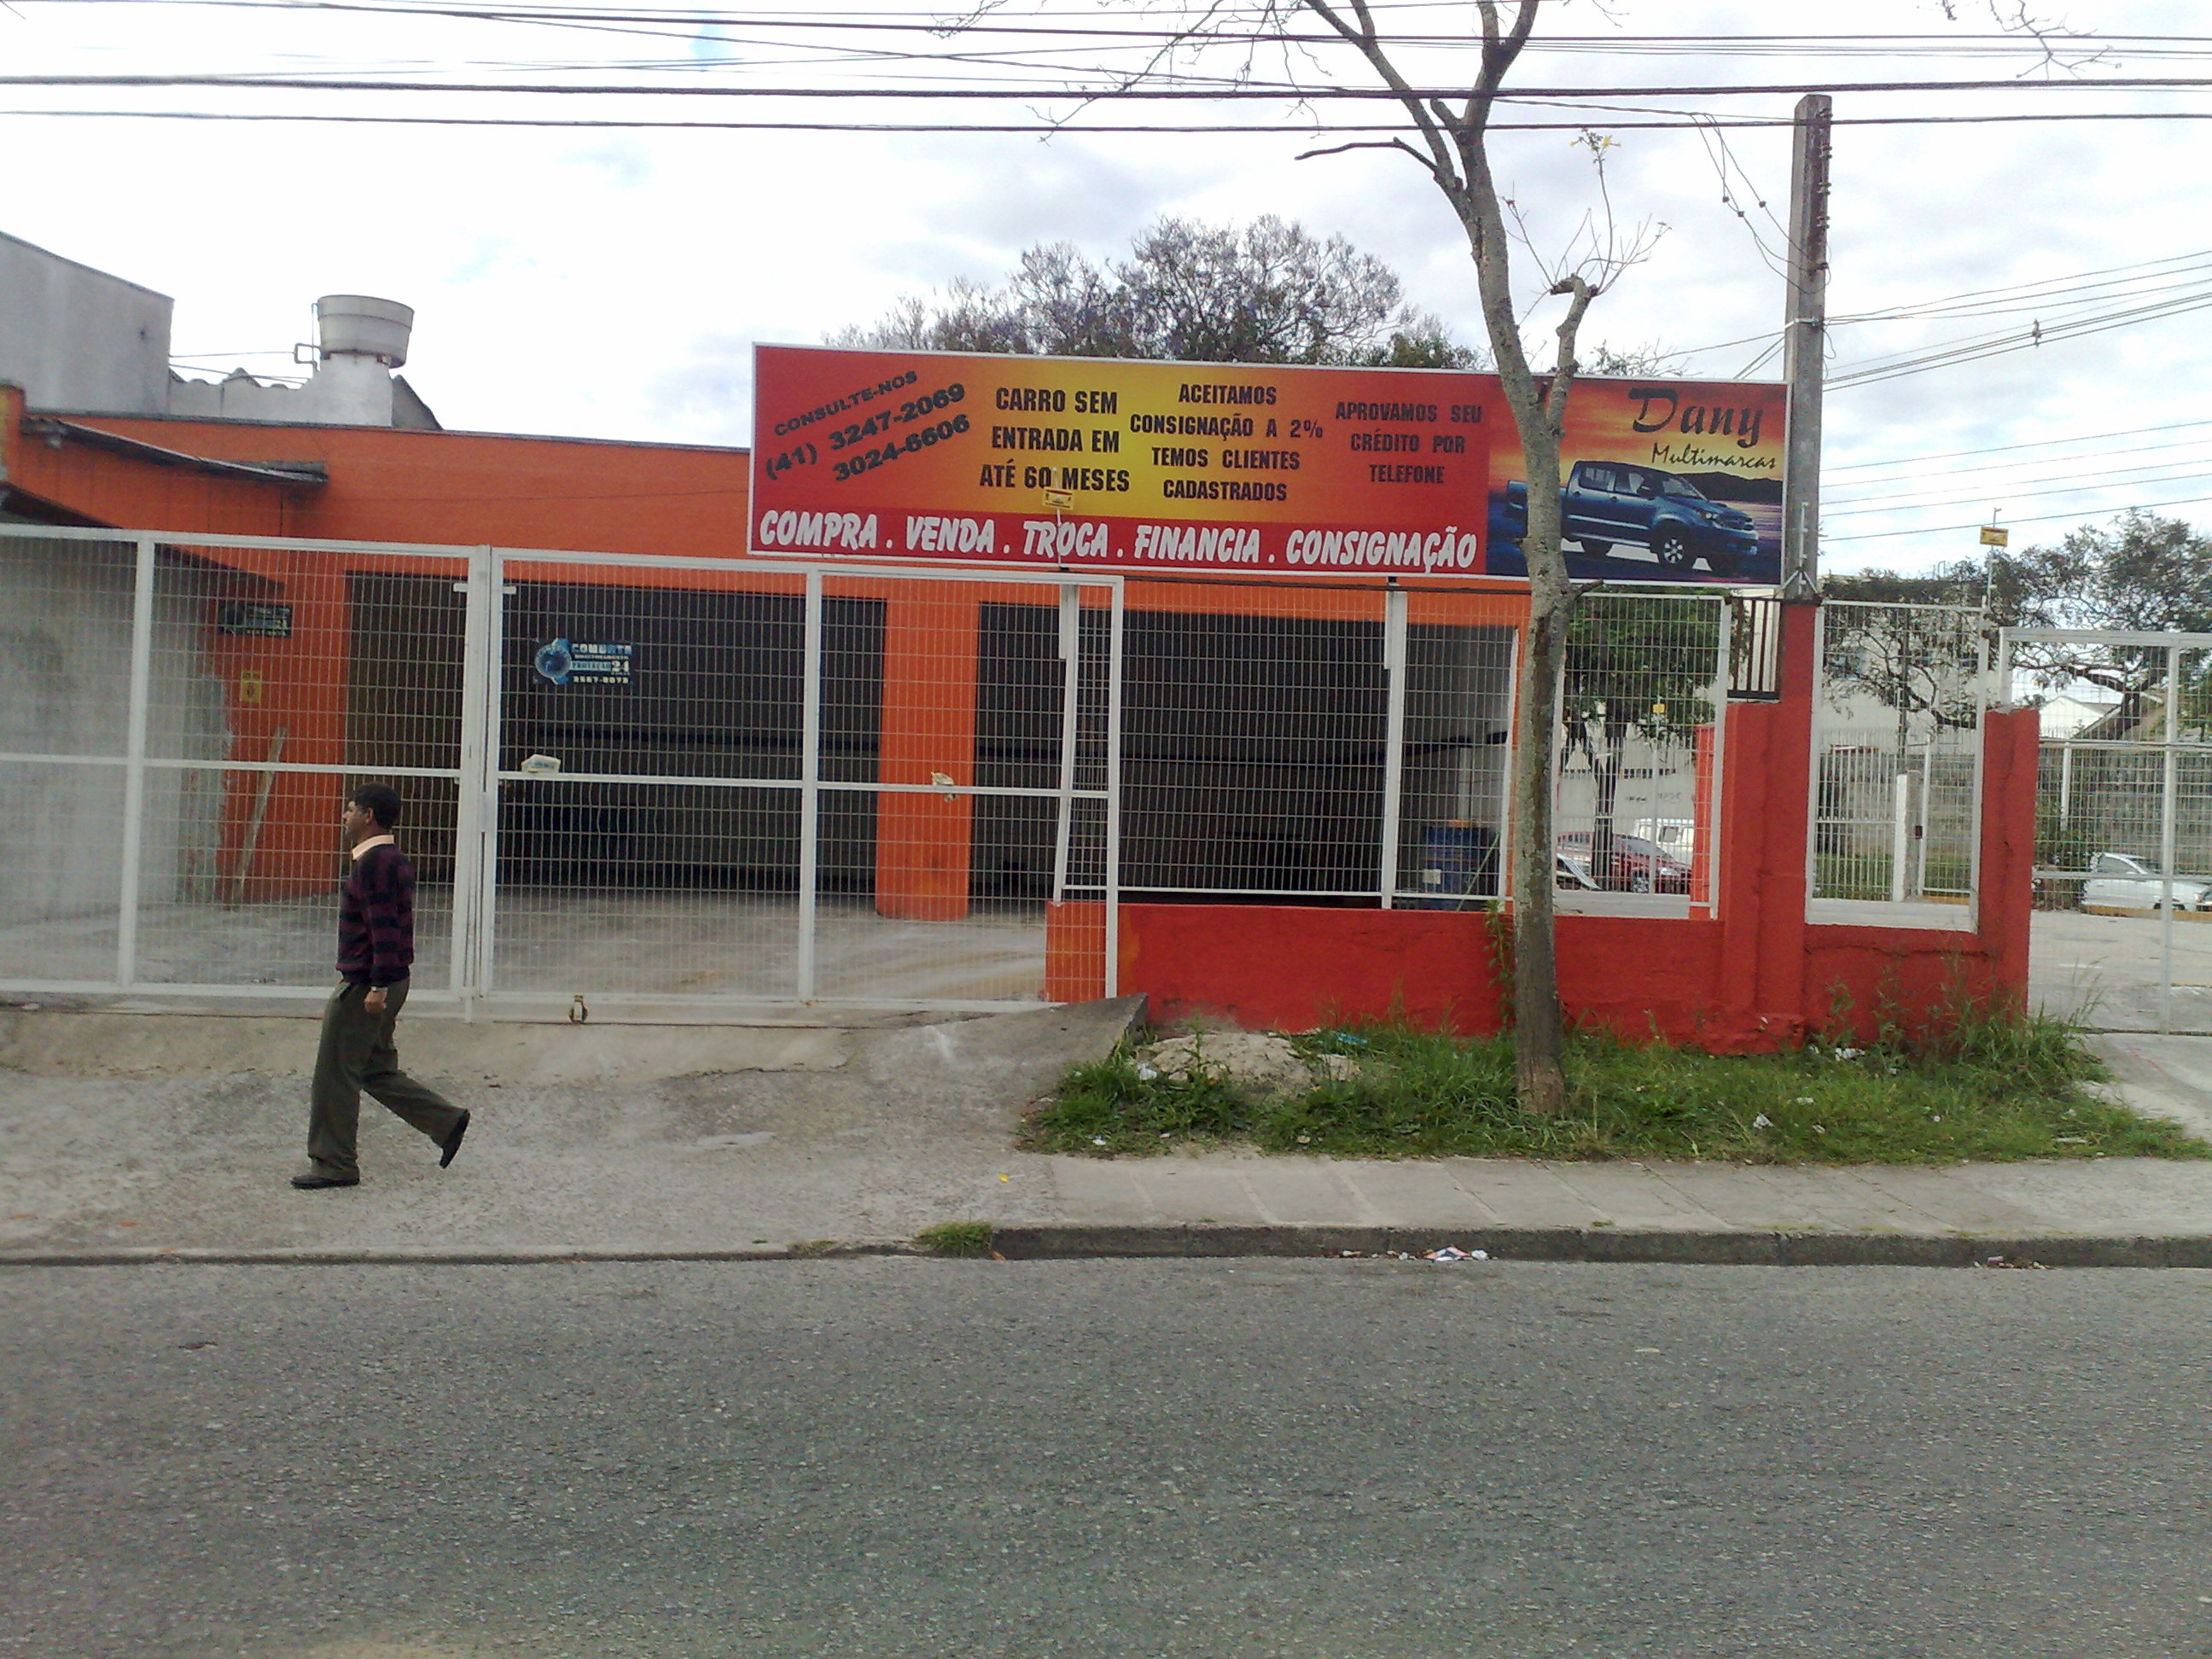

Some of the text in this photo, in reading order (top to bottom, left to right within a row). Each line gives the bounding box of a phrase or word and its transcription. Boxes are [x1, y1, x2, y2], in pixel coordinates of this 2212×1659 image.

[774, 370, 917, 435] CONSULTE-NOS
[996, 387, 1118, 415] CARRO SEM
[1179, 384, 1277, 405] ACEITAMOS
[1336, 402, 1481, 424] APROVAMOS SEU
[1628, 387, 1764, 449] Dany
[765, 382, 965, 480] (41) 3247-2069
[992, 426, 1120, 453] ENTRADA EM
[1130, 413, 1323, 441] CONSIGNAÇÃO A 2%
[833, 414, 969, 480] 3024-6606
[1351, 429, 1465, 454] CRÉDITO POR
[1152, 447, 1301, 470] TEMOS CLIENTES
[1651, 442, 1777, 469] Multimarcas
[980, 458, 1130, 492] ATÉ 60 MESES
[1369, 464, 1445, 484] TELEFONE
[1163, 480, 1288, 502] CADASTRADOS
[760, 509, 1477, 573] COMPRA VENDA TROCA FINANCIA CONSIGNAÇÃO
